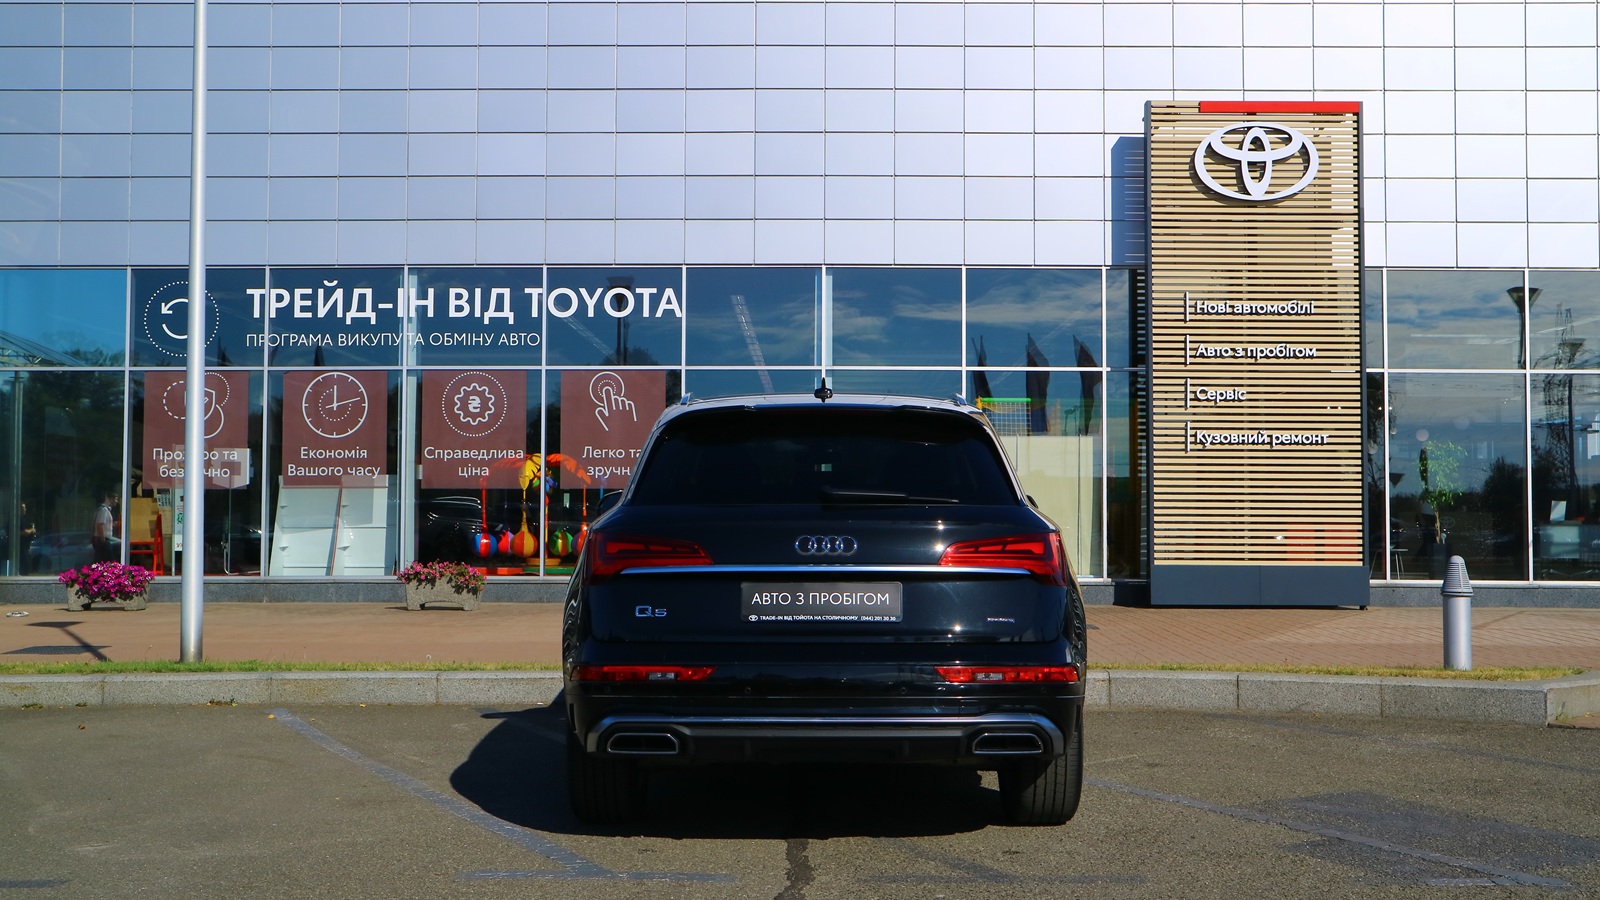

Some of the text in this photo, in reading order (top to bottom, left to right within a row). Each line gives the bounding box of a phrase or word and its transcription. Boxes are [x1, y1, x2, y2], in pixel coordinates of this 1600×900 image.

[246, 280, 682, 325] ТРЕЙД-ІН ВІД TOYOTA
[1196, 300, 1314, 314] Нові автомобілі
[246, 332, 540, 347] ПРОГРАМА ВИКУПУ ТА ОБМІНУ АВТО
[1196, 344, 1317, 360] Авто з пробігом
[1196, 387, 1247, 402] Сервіс
[1196, 430, 1329, 448] Кузовний ремонт
[222, 450, 238, 460] та
[300, 446, 367, 459] Економія
[424, 446, 524, 461] Справедлива
[582, 446, 625, 458] Легко
[160, 465, 230, 477] безчно
[287, 464, 381, 479] Вашого часу
[458, 464, 489, 478] ціна
[751, 592, 890, 605] АВТО З ПРОБІГОМ
[635, 605, 667, 617] Q5
